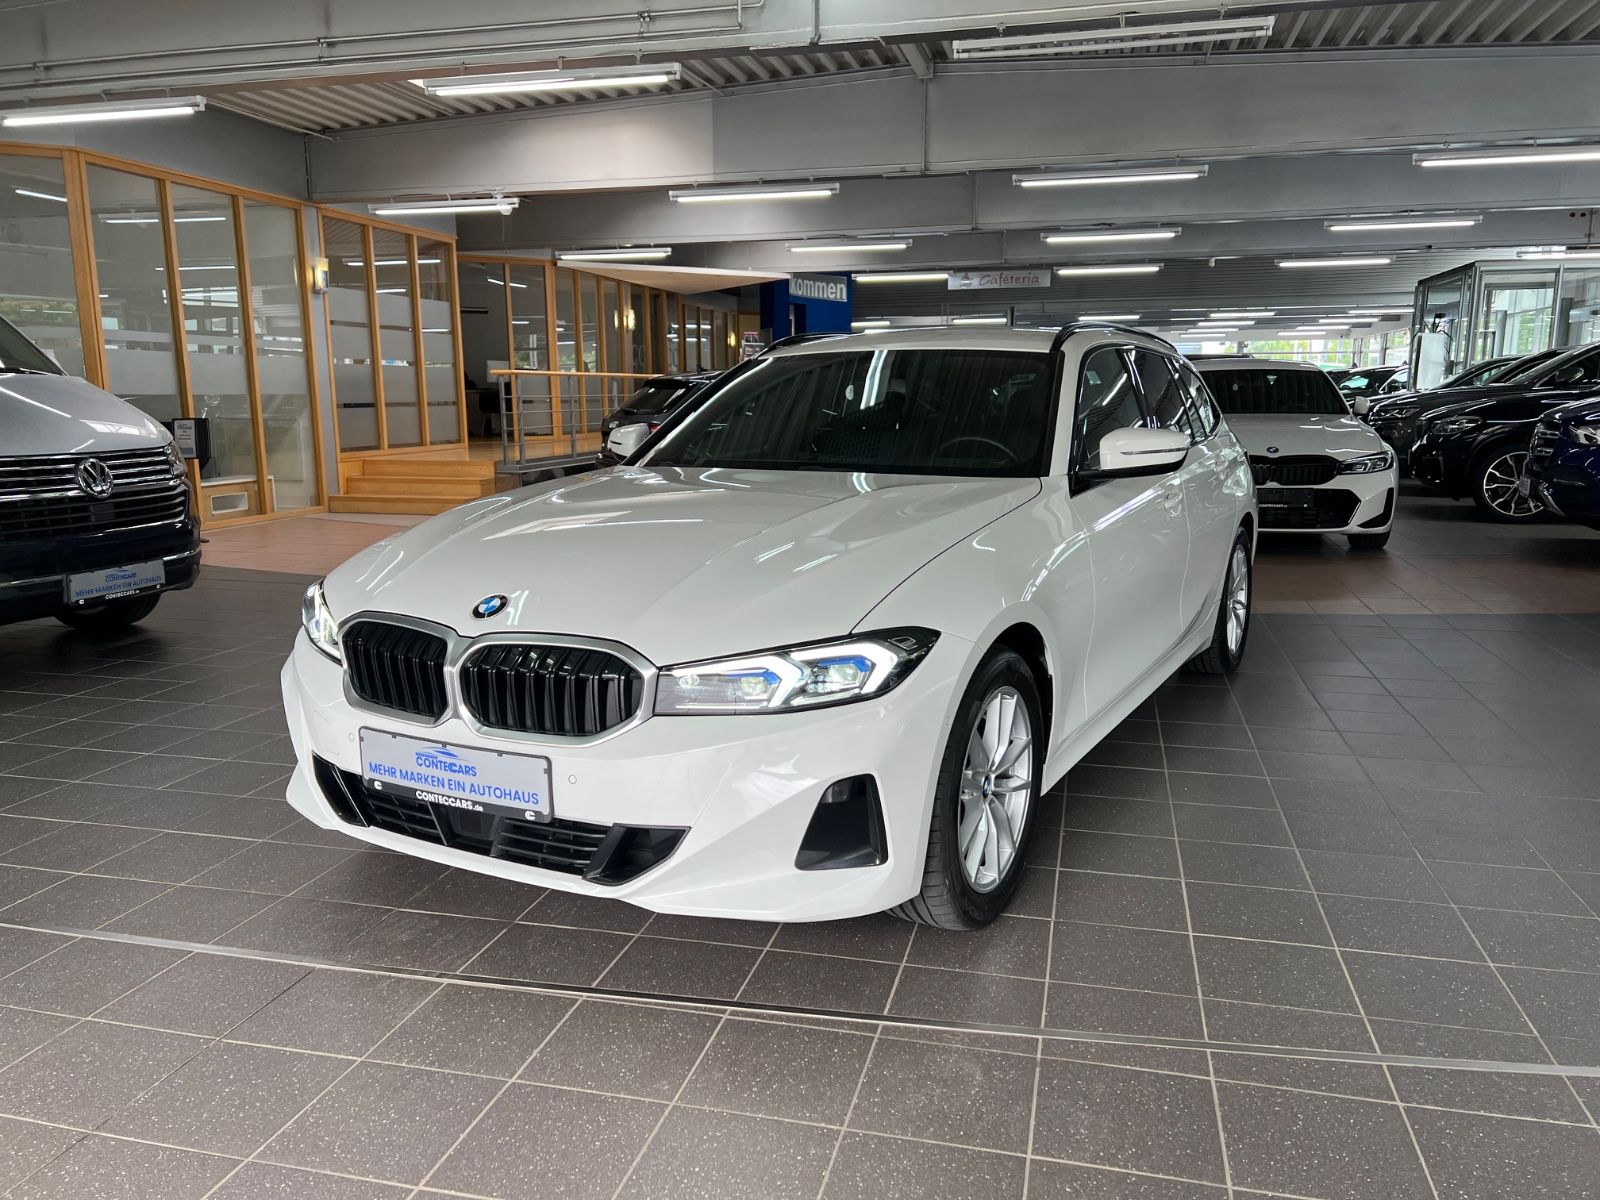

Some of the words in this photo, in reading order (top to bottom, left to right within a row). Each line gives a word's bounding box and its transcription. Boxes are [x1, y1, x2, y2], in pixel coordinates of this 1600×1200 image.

[76, 589, 94, 597] MEHR
[95, 583, 121, 594] MARKEN
[369, 761, 397, 779] MEHR
[399, 768, 445, 789] MARKEN
[447, 778, 466, 793] EIN
[469, 783, 539, 805] AUTOHAUS
[416, 790, 484, 812] CONTECCARS.de
